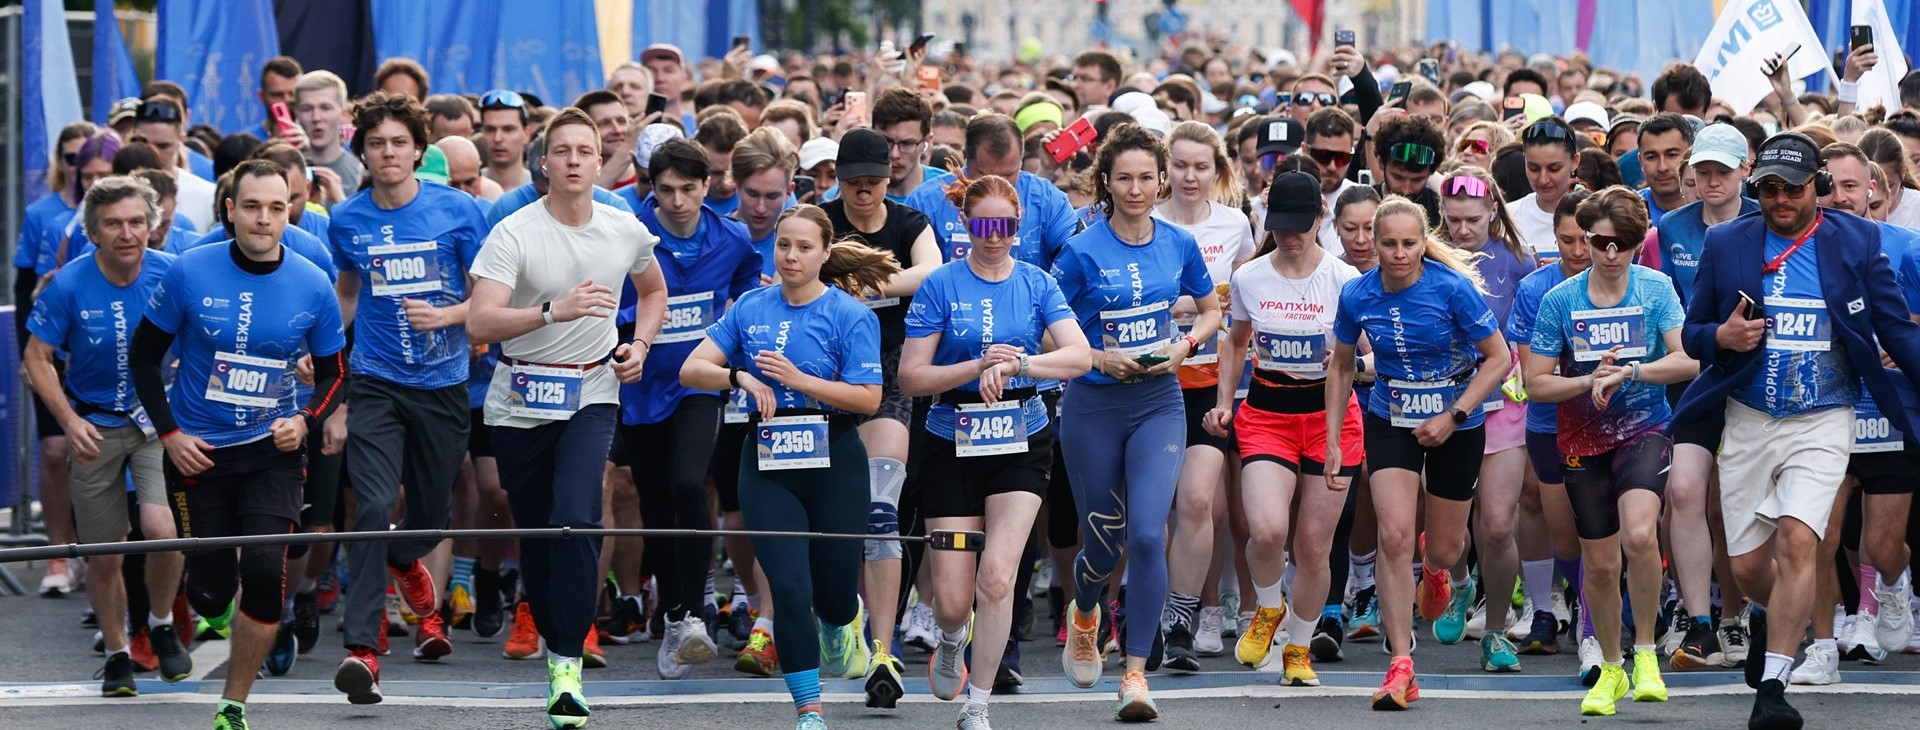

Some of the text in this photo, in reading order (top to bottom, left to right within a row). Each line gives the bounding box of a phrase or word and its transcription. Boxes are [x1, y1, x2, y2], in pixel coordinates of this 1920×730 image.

[1780, 149, 1802, 157] RUSSIA
[383, 256, 426, 281] 1090
[1127, 262, 1143, 306] ЕЖДАЙ
[1259, 301, 1324, 313] УРАЛХИМ
[236, 292, 253, 356] ОБЕЖДАЙ
[981, 298, 992, 356] ОБЕЖДАЙ
[1118, 318, 1157, 343] 2192
[1589, 322, 1630, 345] 3501
[1776, 313, 1817, 336] 1247
[111, 300, 128, 372] ПОБЕЖДАЙ
[1271, 339, 1312, 359] 3004
[227, 368, 268, 393] 1091
[1766, 351, 1780, 409] #БОРИСЬ
[526, 381, 565, 405] 3125
[1401, 393, 1444, 414] 2406
[970, 416, 1014, 439] 2492
[1856, 417, 1889, 439] 080
[771, 430, 814, 453] 2359
